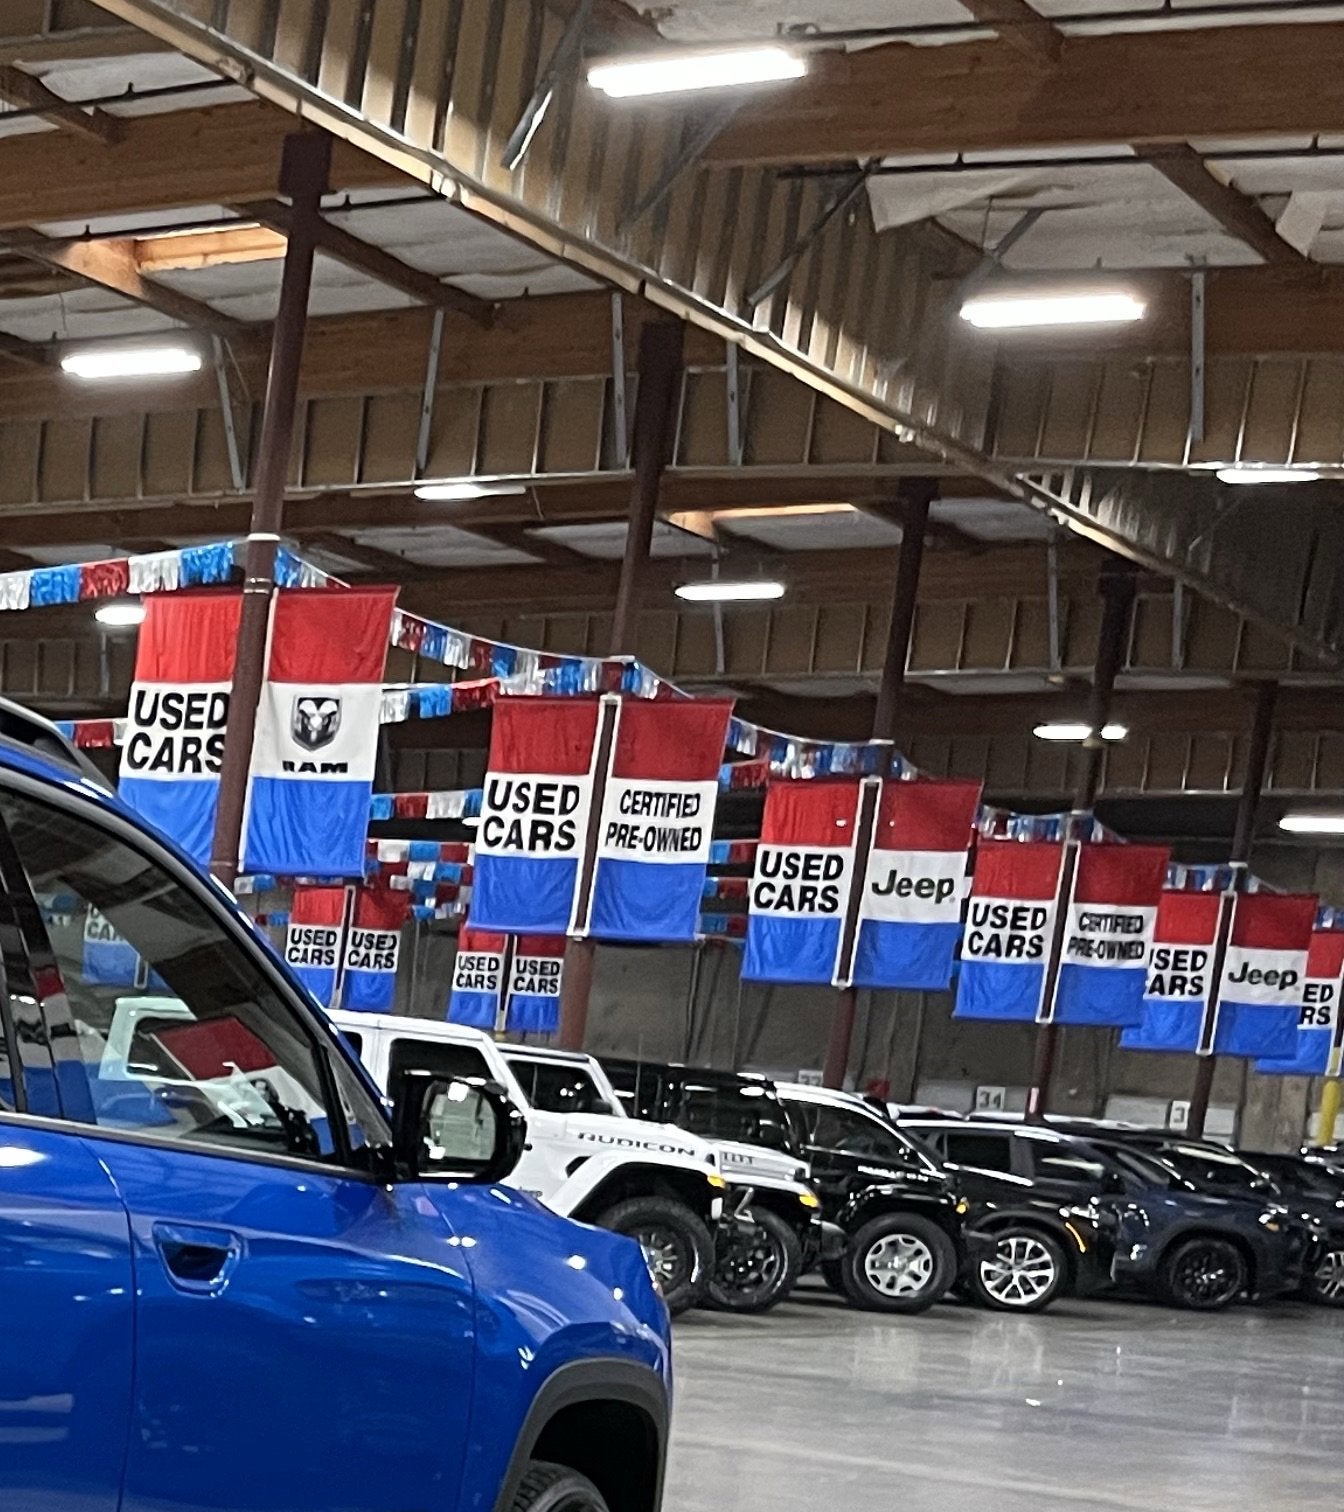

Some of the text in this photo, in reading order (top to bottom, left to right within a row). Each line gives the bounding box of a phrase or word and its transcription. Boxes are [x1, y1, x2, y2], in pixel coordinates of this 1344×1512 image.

[134, 690, 229, 731] USED
[127, 732, 225, 773] CARS
[488, 780, 580, 816] USED
[620, 789, 701, 819] CERTIFIED
[483, 816, 576, 851] CARS
[605, 822, 702, 852] PRE-OWNED
[760, 850, 844, 881] USED
[754, 882, 839, 913] CARS
[872, 869, 954, 904] Jeep
[972, 903, 1047, 931] USED
[1079, 912, 1144, 934] CERTIFIED
[291, 928, 337, 947] USED
[351, 931, 397, 950] USED
[968, 931, 1044, 958] CARS
[1067, 936, 1145, 960] PRE-OWNED
[288, 946, 335, 966] CARS
[348, 950, 395, 970] CARS
[458, 955, 500, 972] USED
[516, 958, 560, 976] USED
[456, 972, 497, 989] CARS
[513, 975, 559, 994] CARS
[1148, 974, 1204, 996] ARS
[1228, 961, 1298, 991] Jeep
[1302, 984, 1334, 1003] ED
[578, 1131, 696, 1157] RUBICON
